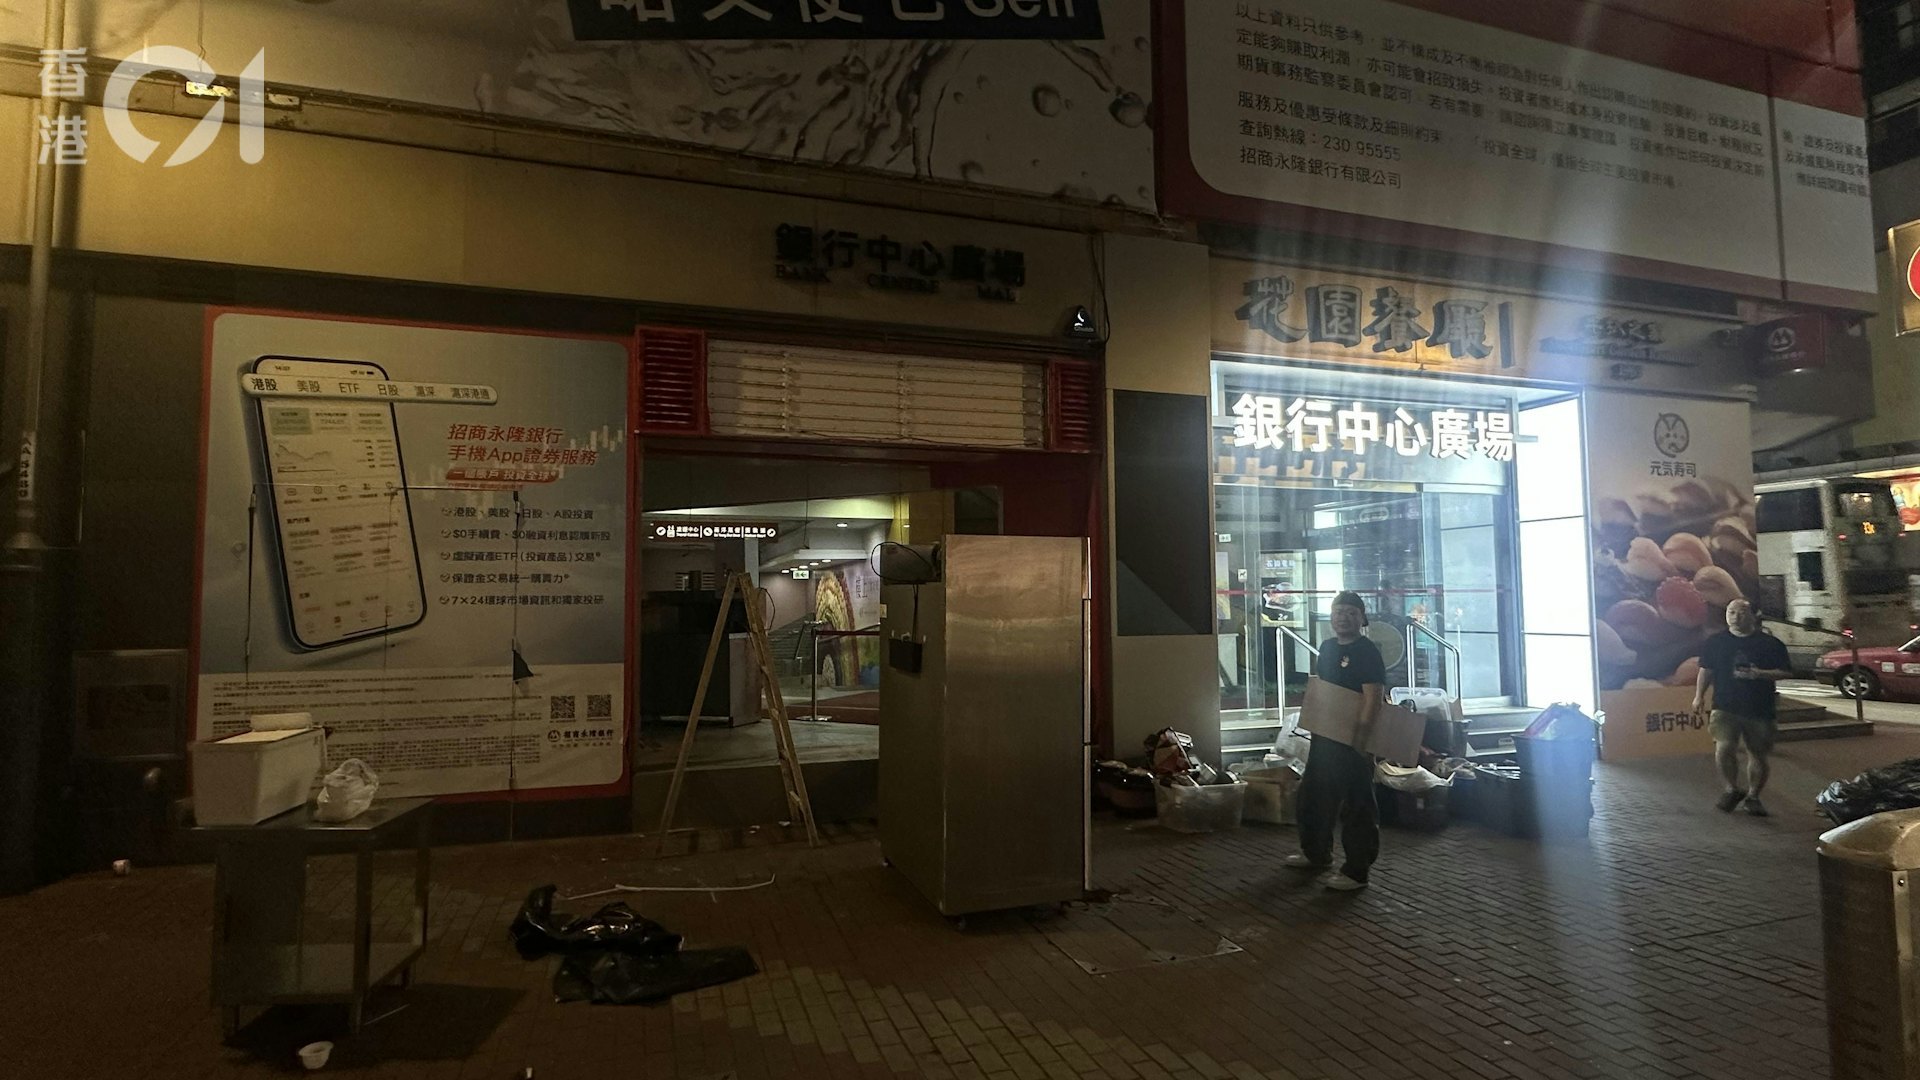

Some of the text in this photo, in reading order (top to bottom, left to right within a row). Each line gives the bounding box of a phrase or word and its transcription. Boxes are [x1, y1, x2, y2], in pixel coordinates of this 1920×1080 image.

[1356, 138, 1401, 161] 95555
[1240, 147, 1402, 189] 招商永隆銀行有限公司
[251, 377, 279, 392] 港股
[296, 380, 321, 394] 美股
[338, 382, 361, 394] ETF
[377, 384, 400, 397] 日股
[447, 423, 564, 444] 招商永隆銀行
[1231, 392, 1515, 462] 銀行中心廣場
[447, 444, 600, 466] 手機App證券服務
